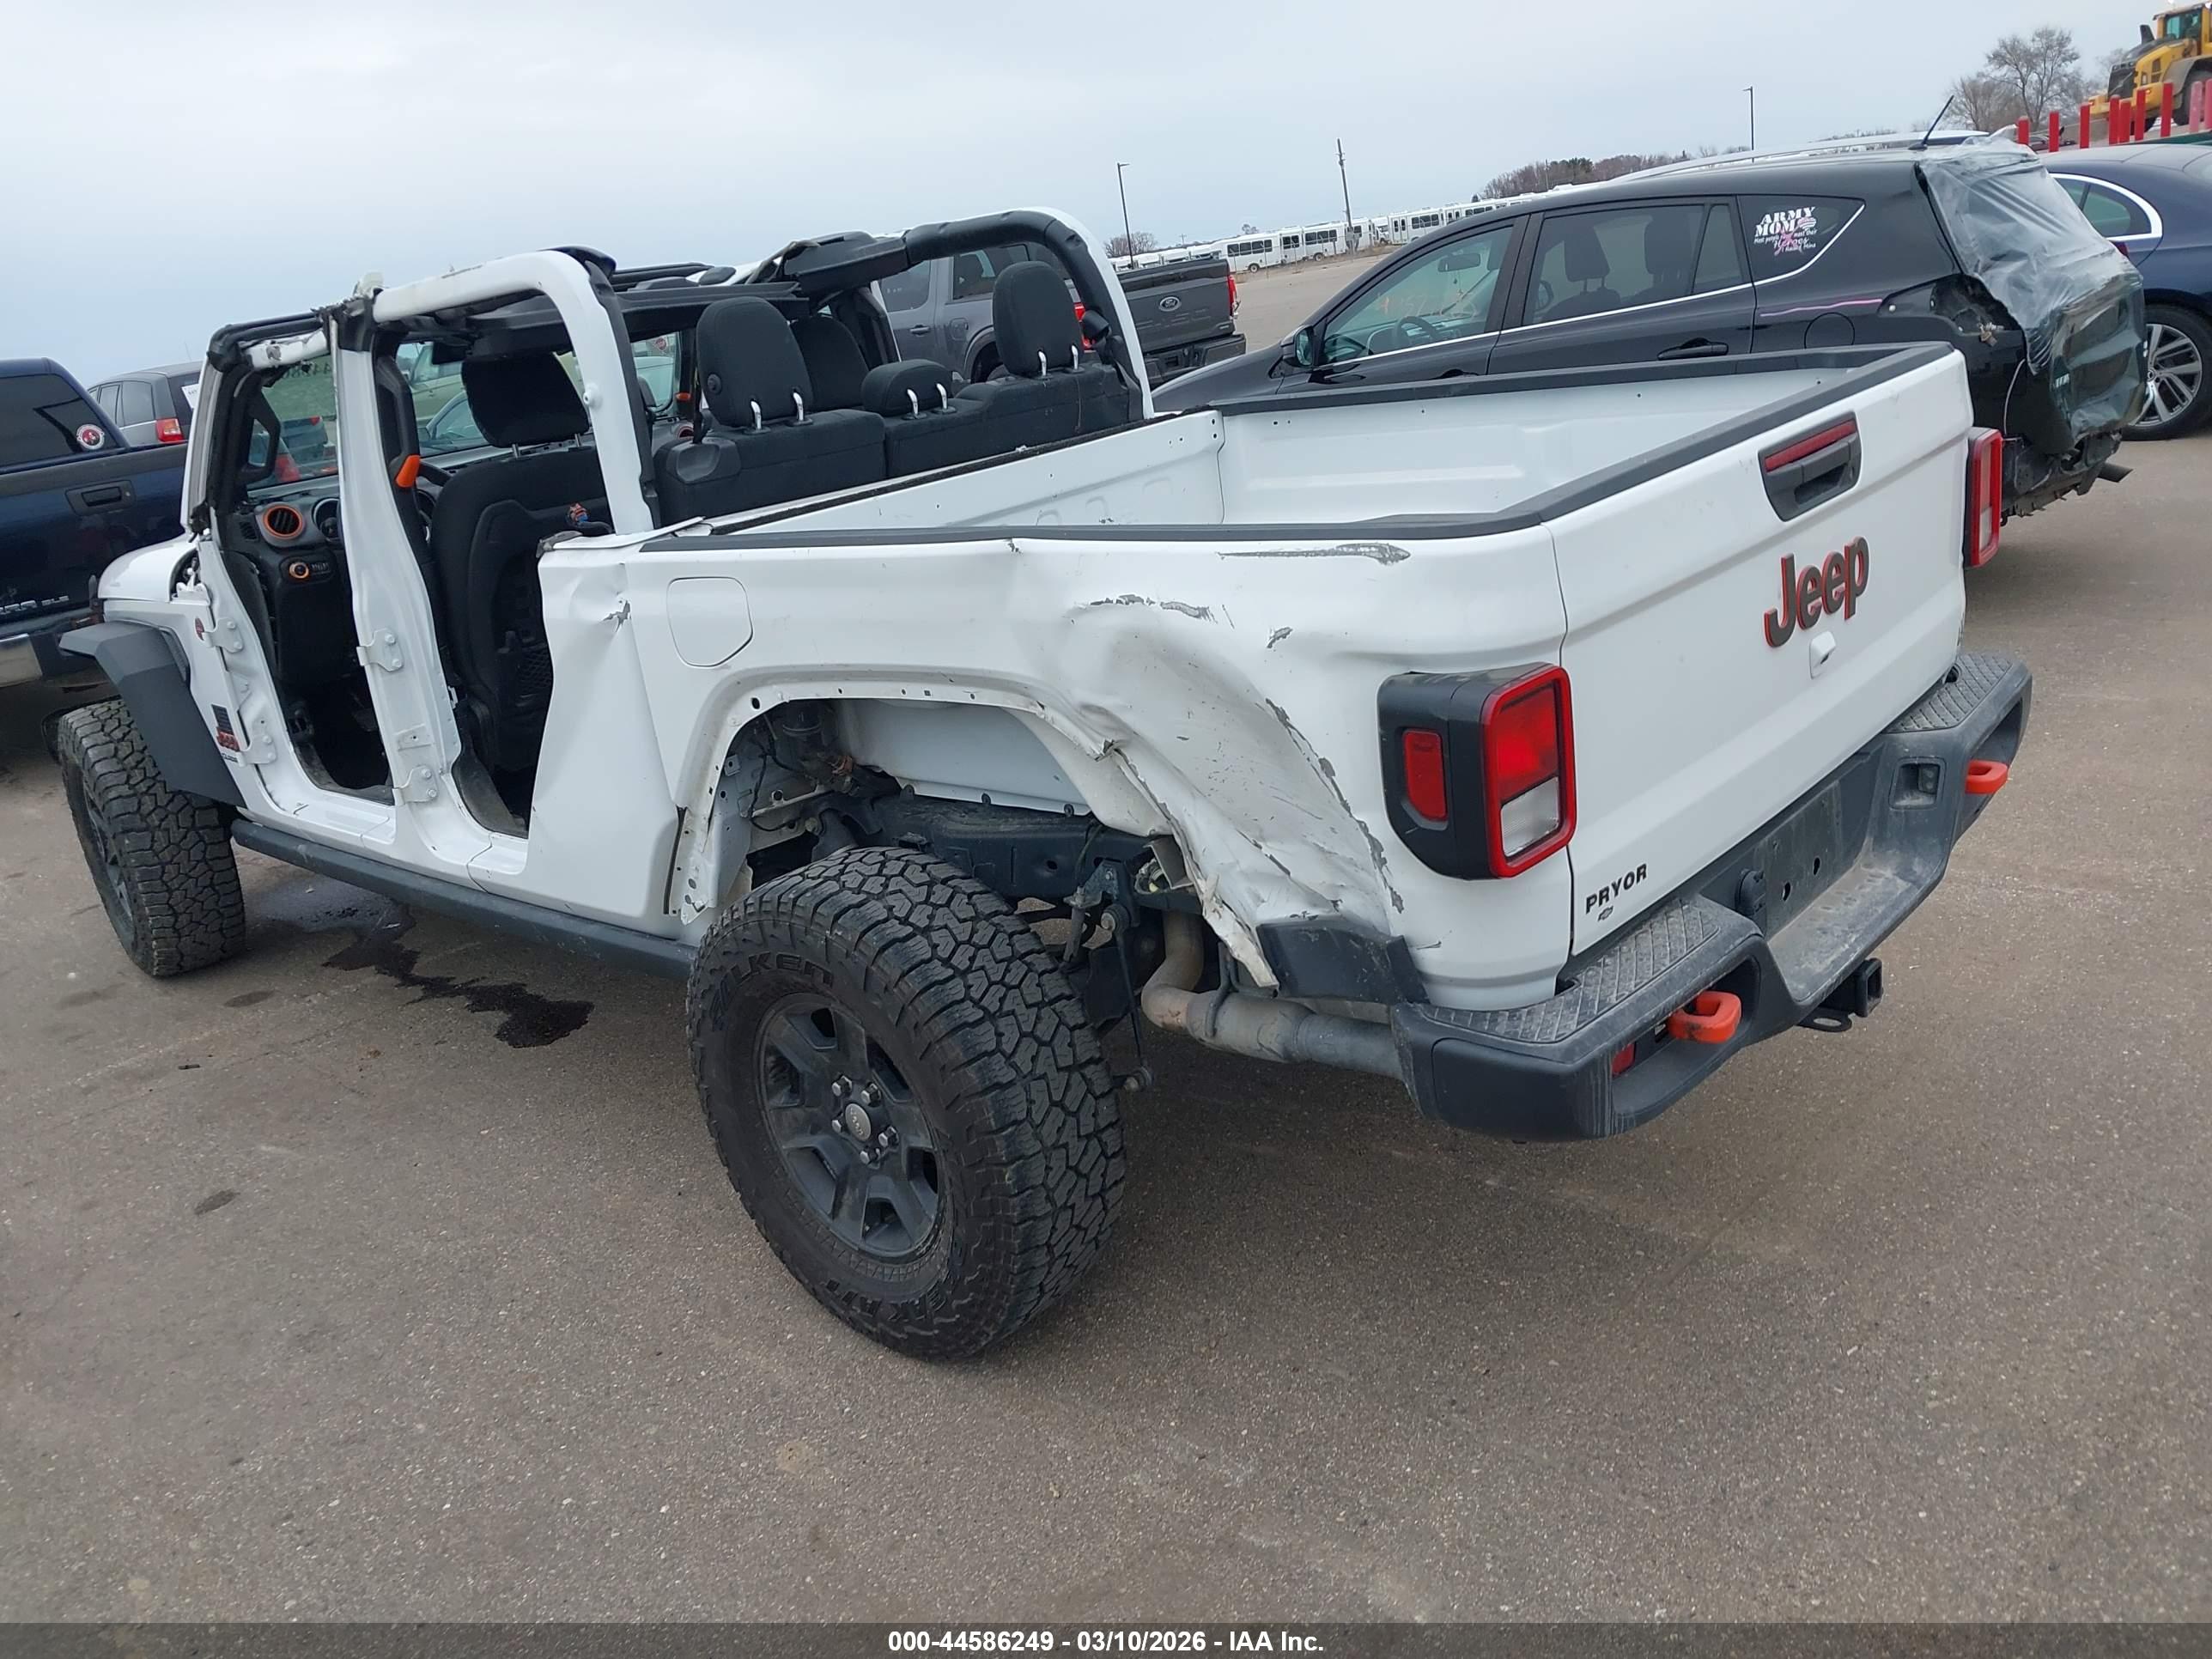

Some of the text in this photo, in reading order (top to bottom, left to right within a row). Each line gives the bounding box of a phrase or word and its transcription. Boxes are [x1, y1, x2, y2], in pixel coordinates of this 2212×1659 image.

[1754, 219, 1796, 237] MOM
[1760, 206, 1815, 225] ARMY
[1764, 536, 1869, 648] Jeep
[1586, 863, 1647, 915] PRYOR
